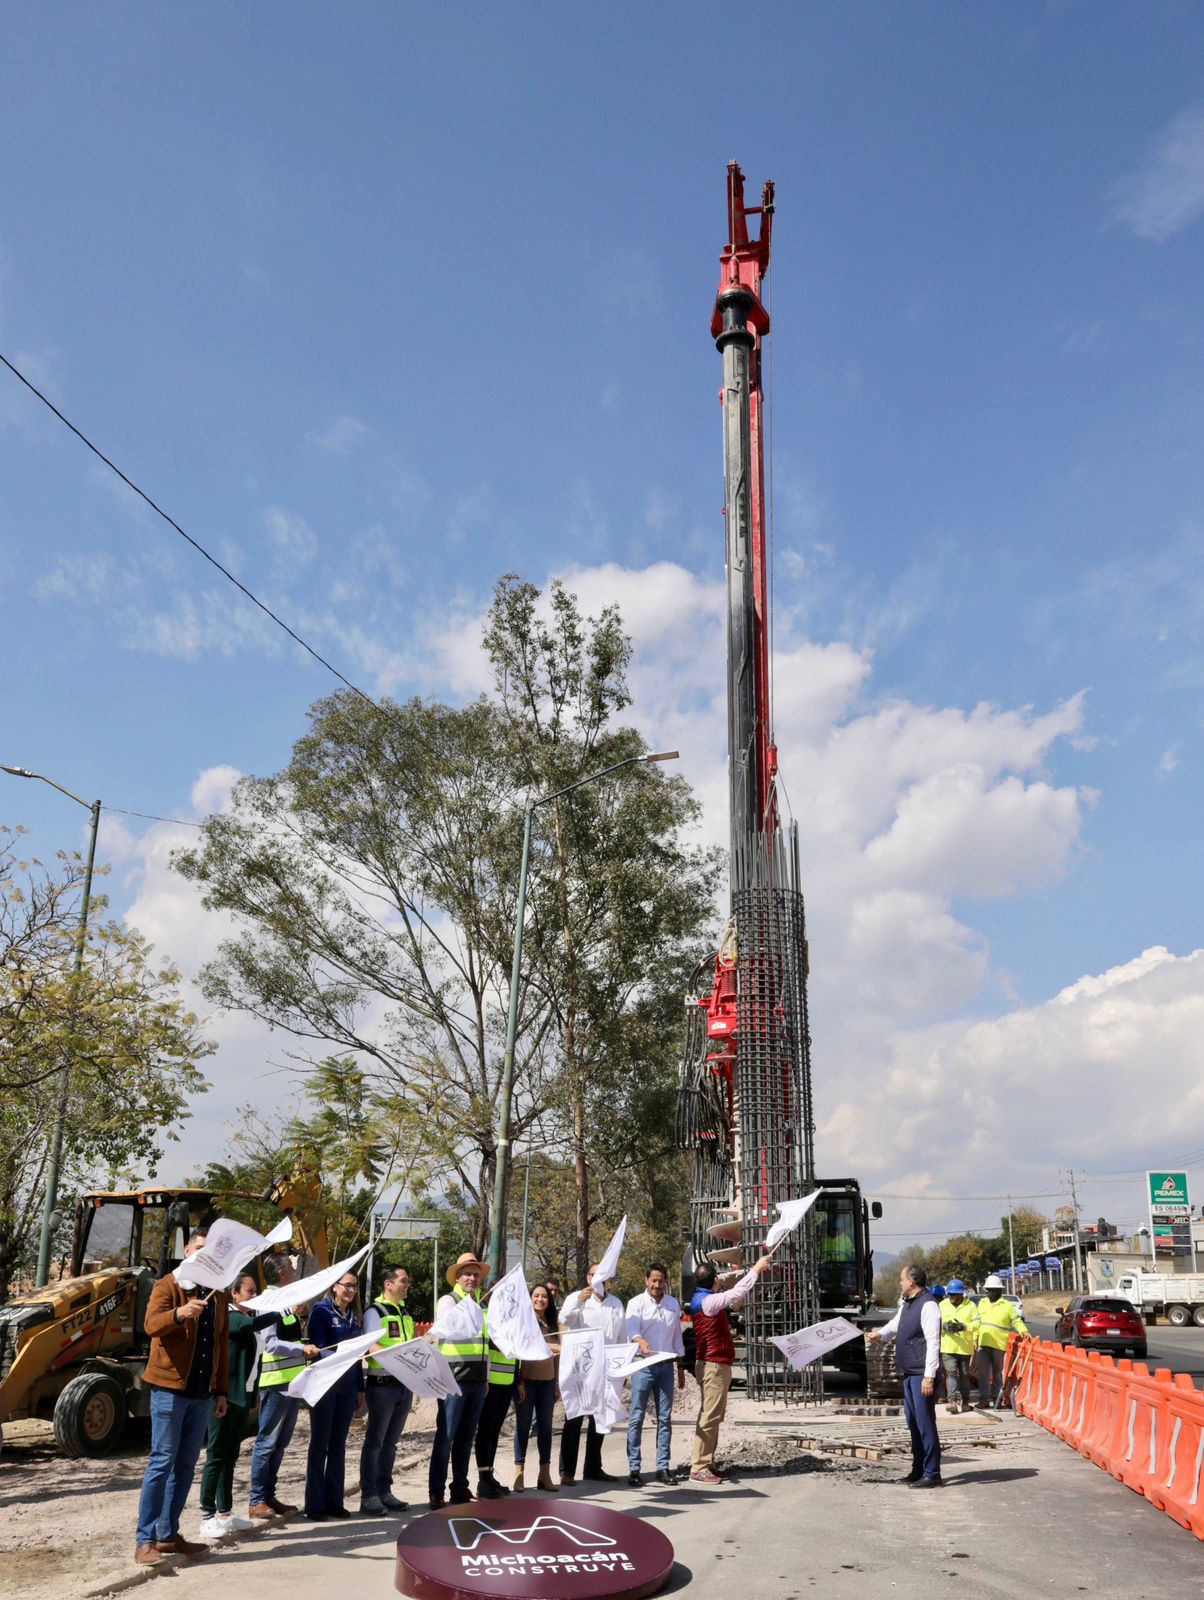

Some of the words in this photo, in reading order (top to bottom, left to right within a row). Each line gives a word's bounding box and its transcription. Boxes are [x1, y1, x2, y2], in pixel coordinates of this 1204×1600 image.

[62, 1311, 92, 1334] FT22
[461, 1551, 629, 1567] Michoacán
[465, 1562, 635, 1577] CONSTRUYE
